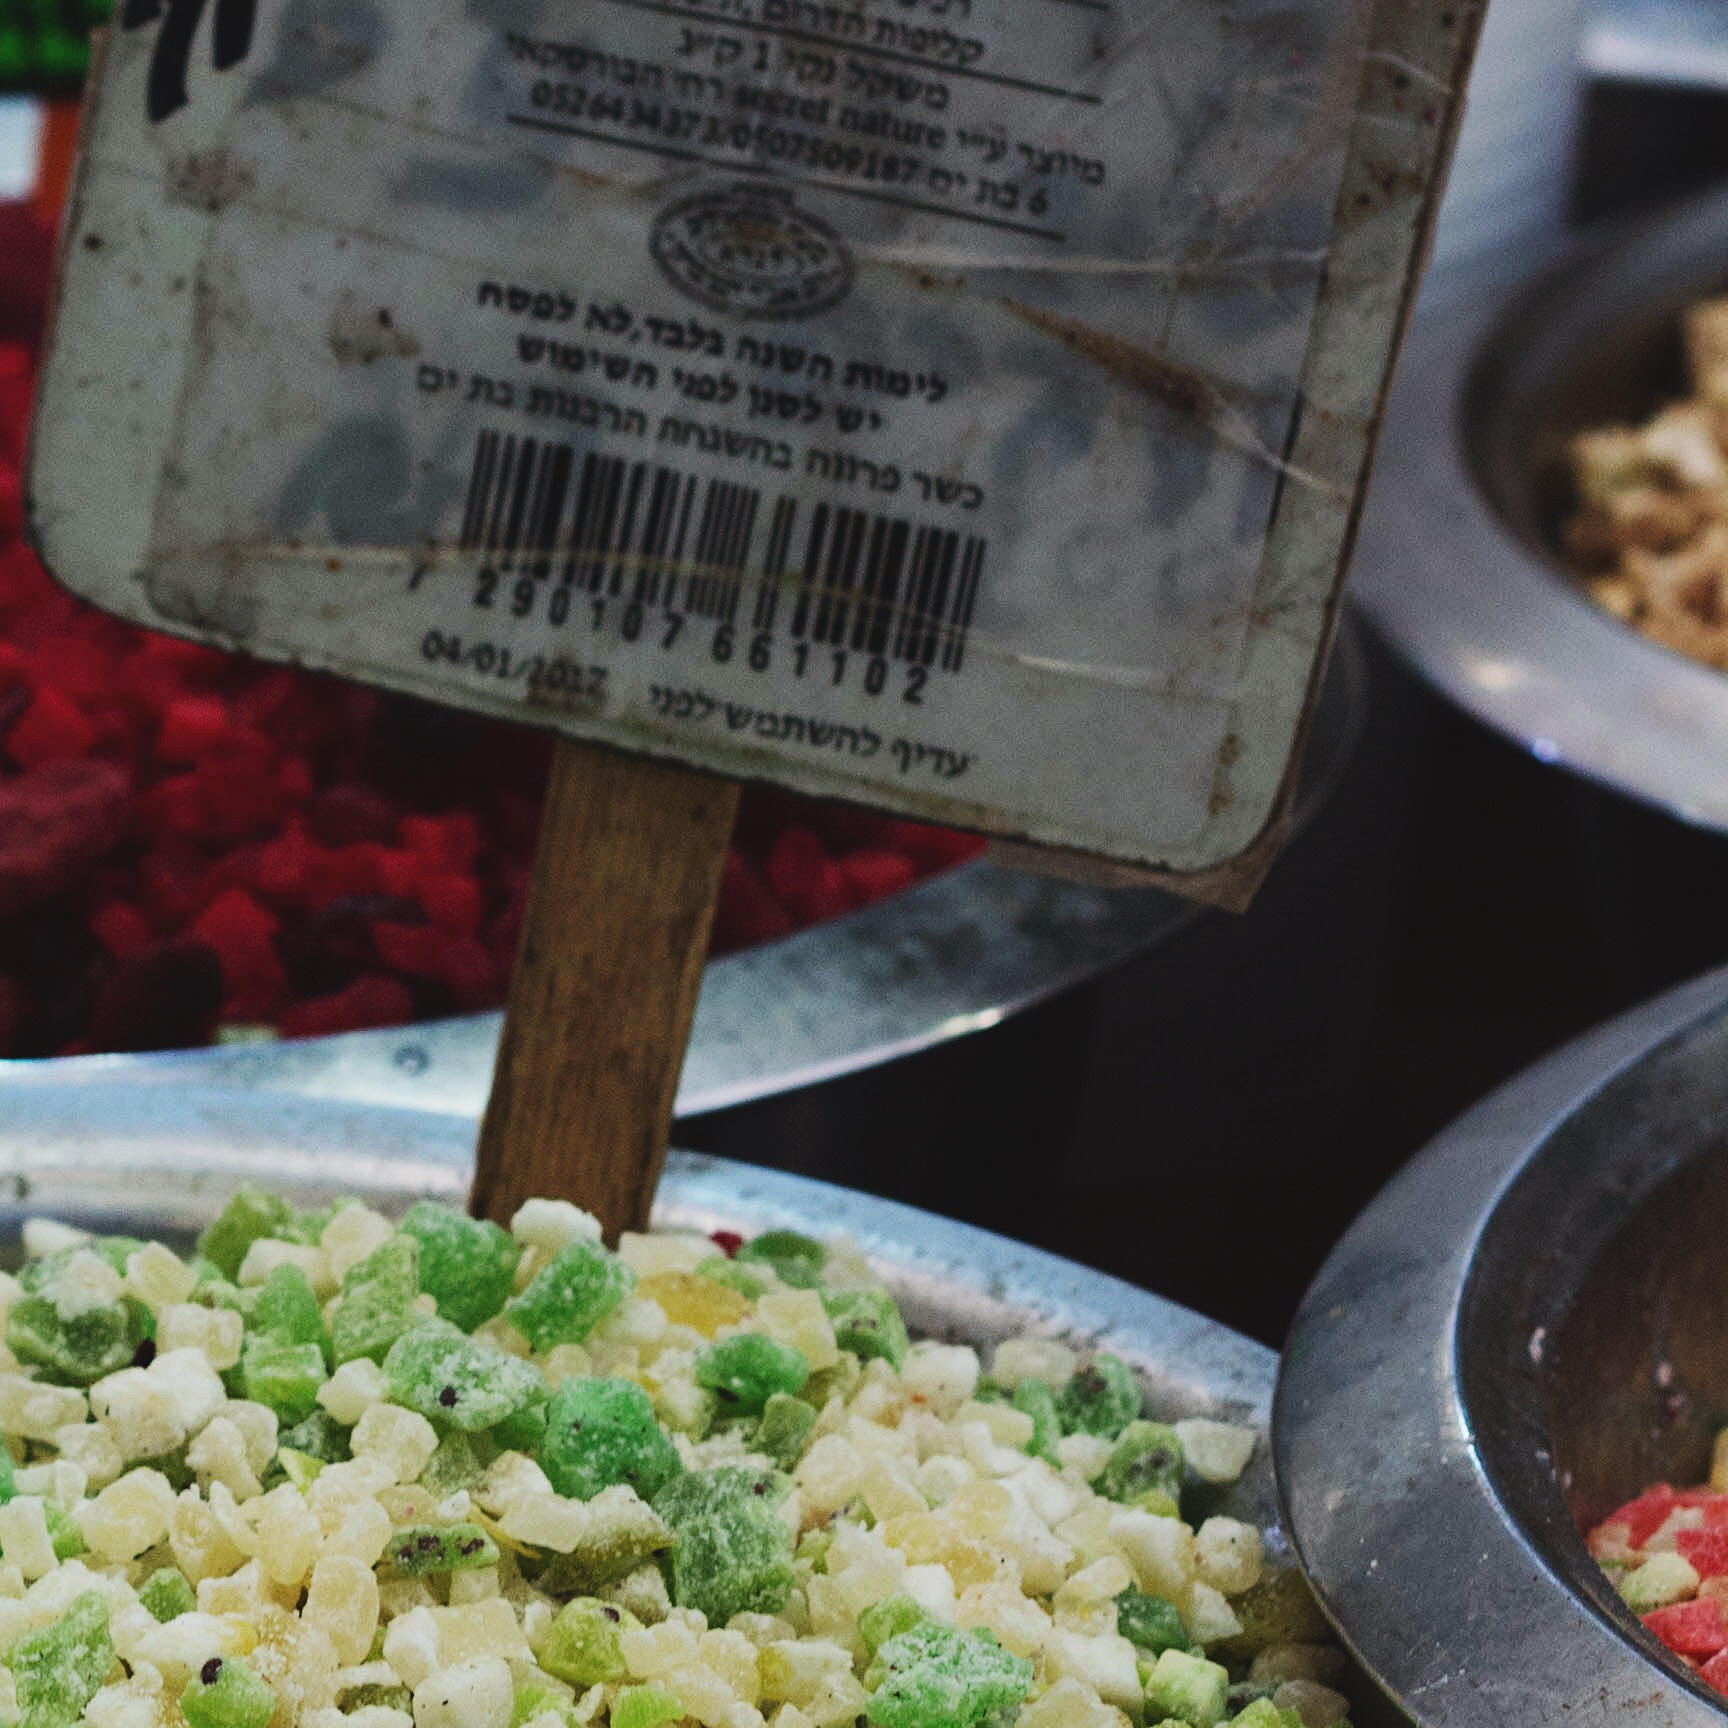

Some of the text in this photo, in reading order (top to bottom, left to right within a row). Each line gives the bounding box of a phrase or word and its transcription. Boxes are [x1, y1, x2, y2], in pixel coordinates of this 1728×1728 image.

[476, 280, 575, 320] לפסח
[416, 363, 458, 393] ים
[516, 333, 658, 389] השימוש
[736, 335, 833, 381] השנה
[465, 373, 514, 408] בת
[671, 367, 739, 404] לפני
[844, 361, 949, 403] לימות
[525, 385, 647, 435] הרבנות
[834, 403, 882, 434] יש
[806, 448, 901, 493] פרווה
[912, 470, 984, 511] כשר
[649, 684, 718, 719] לפני
[725, 702, 882, 757] להשתמש
[890, 737, 971, 779] עדיף
